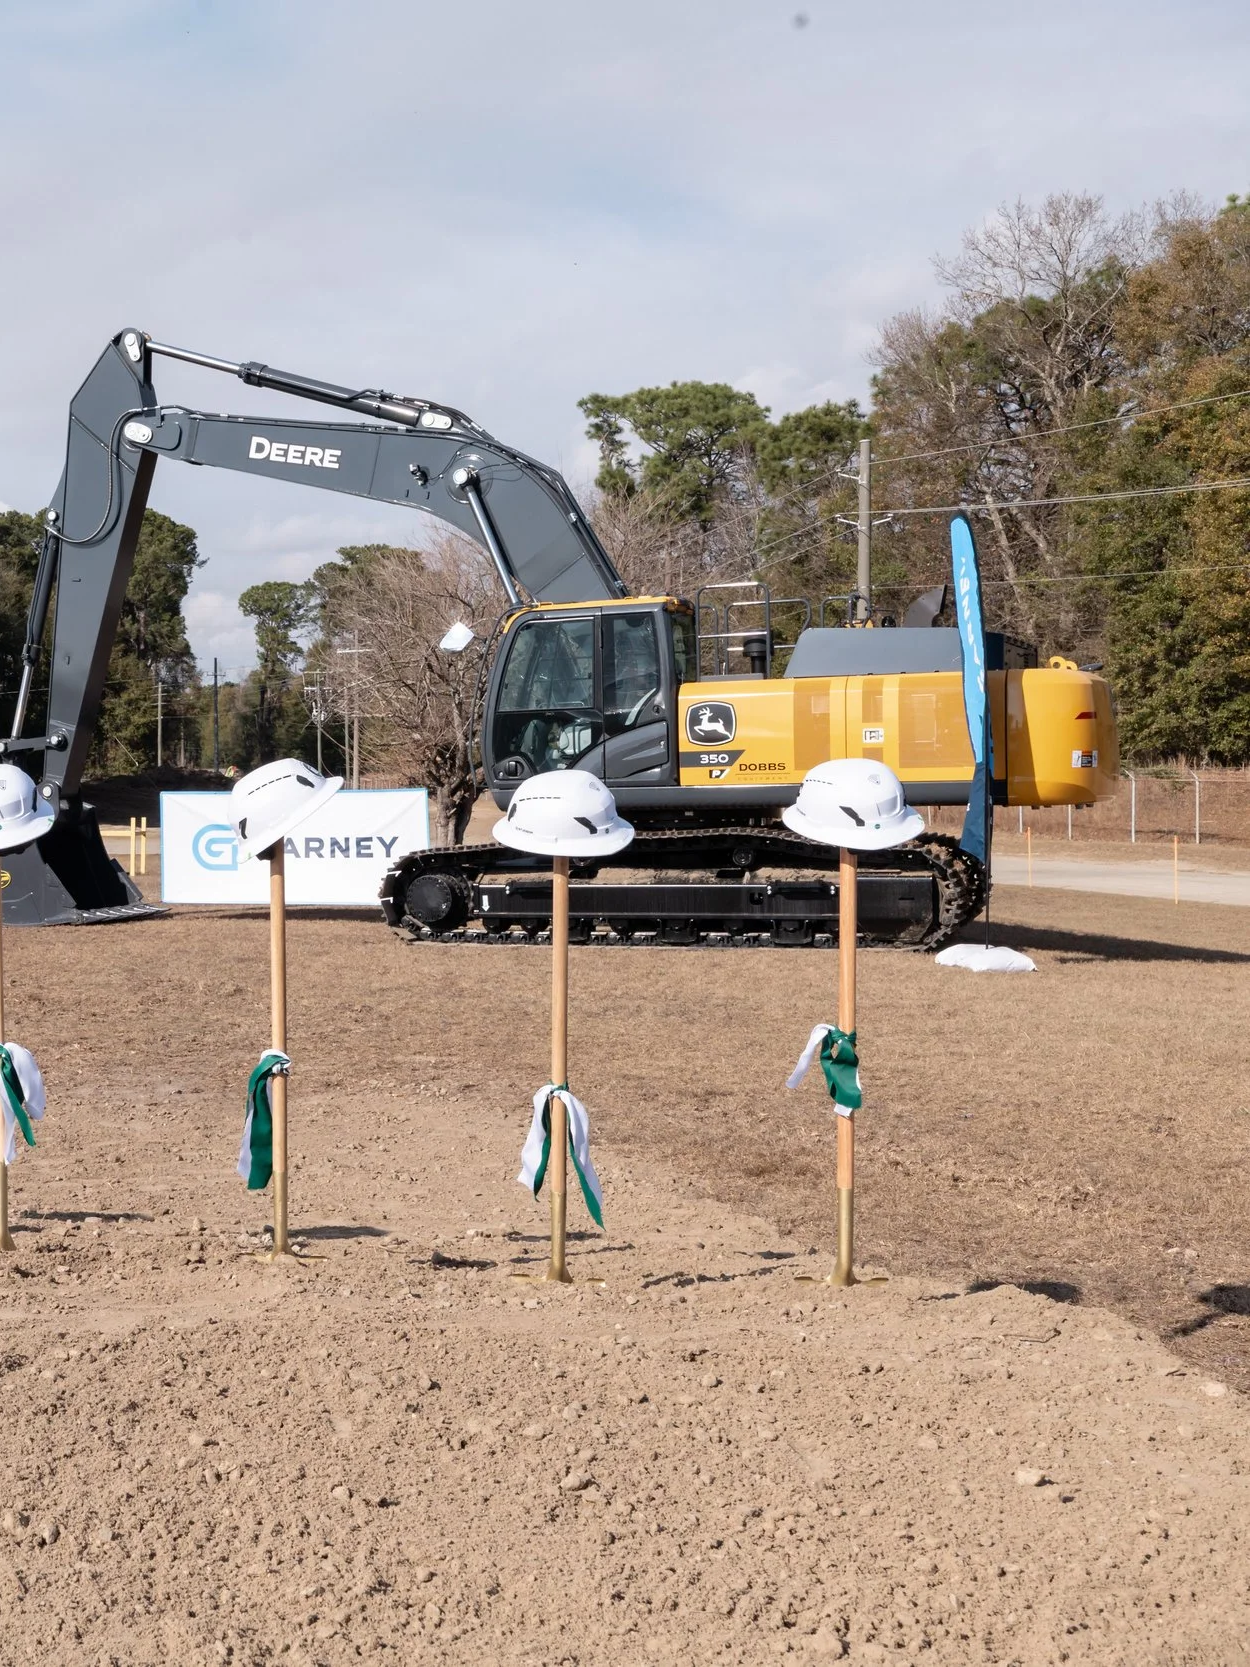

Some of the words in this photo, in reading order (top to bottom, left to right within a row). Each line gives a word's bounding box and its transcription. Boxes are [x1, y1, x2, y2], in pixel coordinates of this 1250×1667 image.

[249, 436, 342, 469] DEERE
[700, 754, 729, 764] 350
[739, 762, 786, 771] DOBBS
[283, 836, 400, 859] ARNEY
